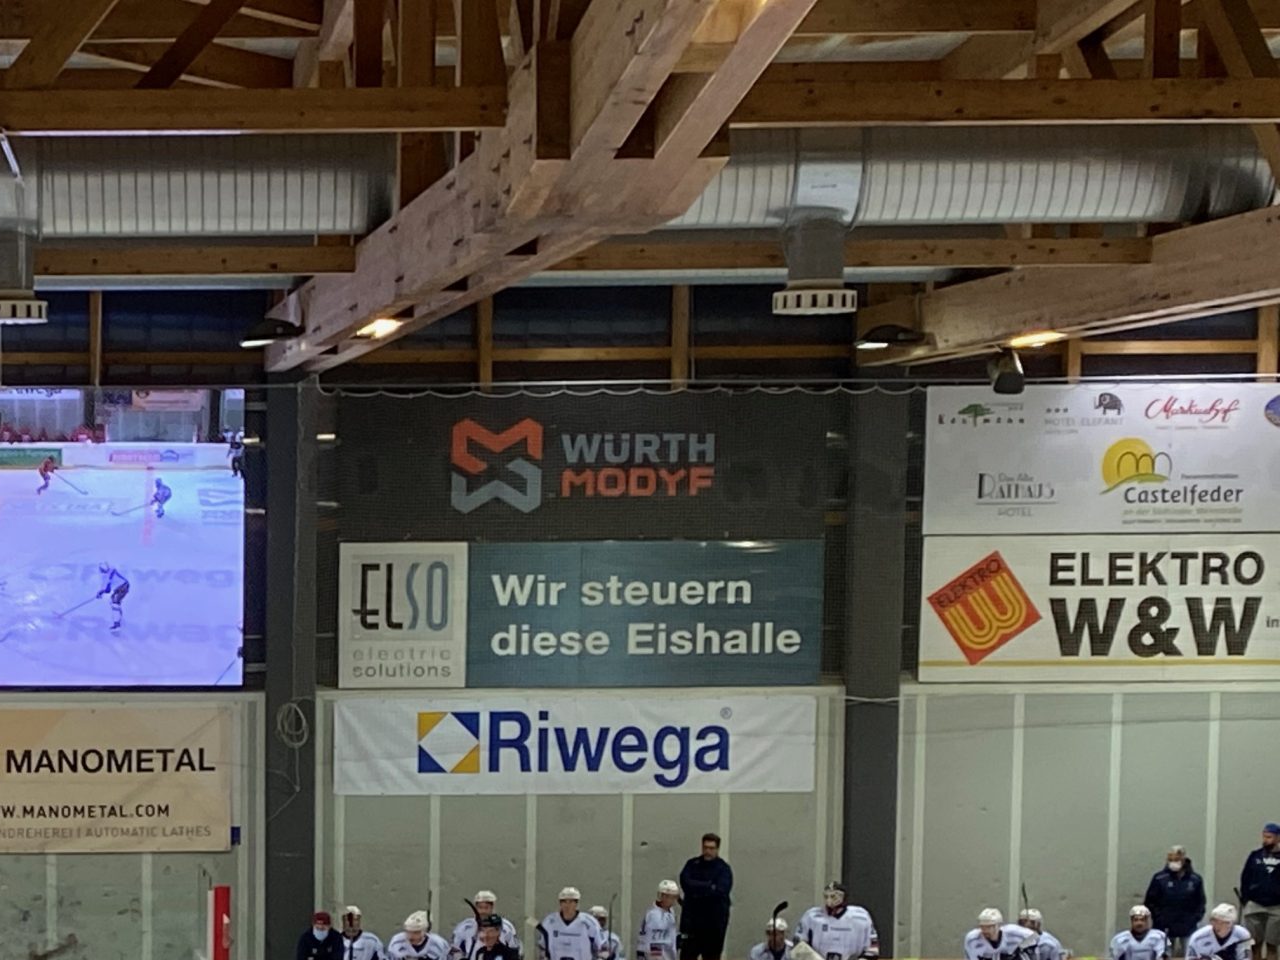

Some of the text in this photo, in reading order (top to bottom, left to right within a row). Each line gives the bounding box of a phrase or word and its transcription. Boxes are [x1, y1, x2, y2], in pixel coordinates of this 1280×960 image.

[561, 433, 715, 464] WÜRTH
[561, 467, 715, 497] MODYF
[1124, 485, 1244, 506] Castelfeder
[1049, 551, 1265, 587] ELEKTRO
[351, 561, 449, 631] ELSO
[491, 574, 752, 606] Wir steuern
[490, 622, 802, 656] diese Eishalle
[1048, 596, 1263, 658] W&W
[353, 646, 451, 661] electric
[352, 662, 451, 679] solutions
[6, 747, 216, 774] MANOMETAL
[488, 711, 730, 788] Riwega
[85, 826, 158, 839] AUTOMATIC
[162, 825, 211, 838] LATHES
